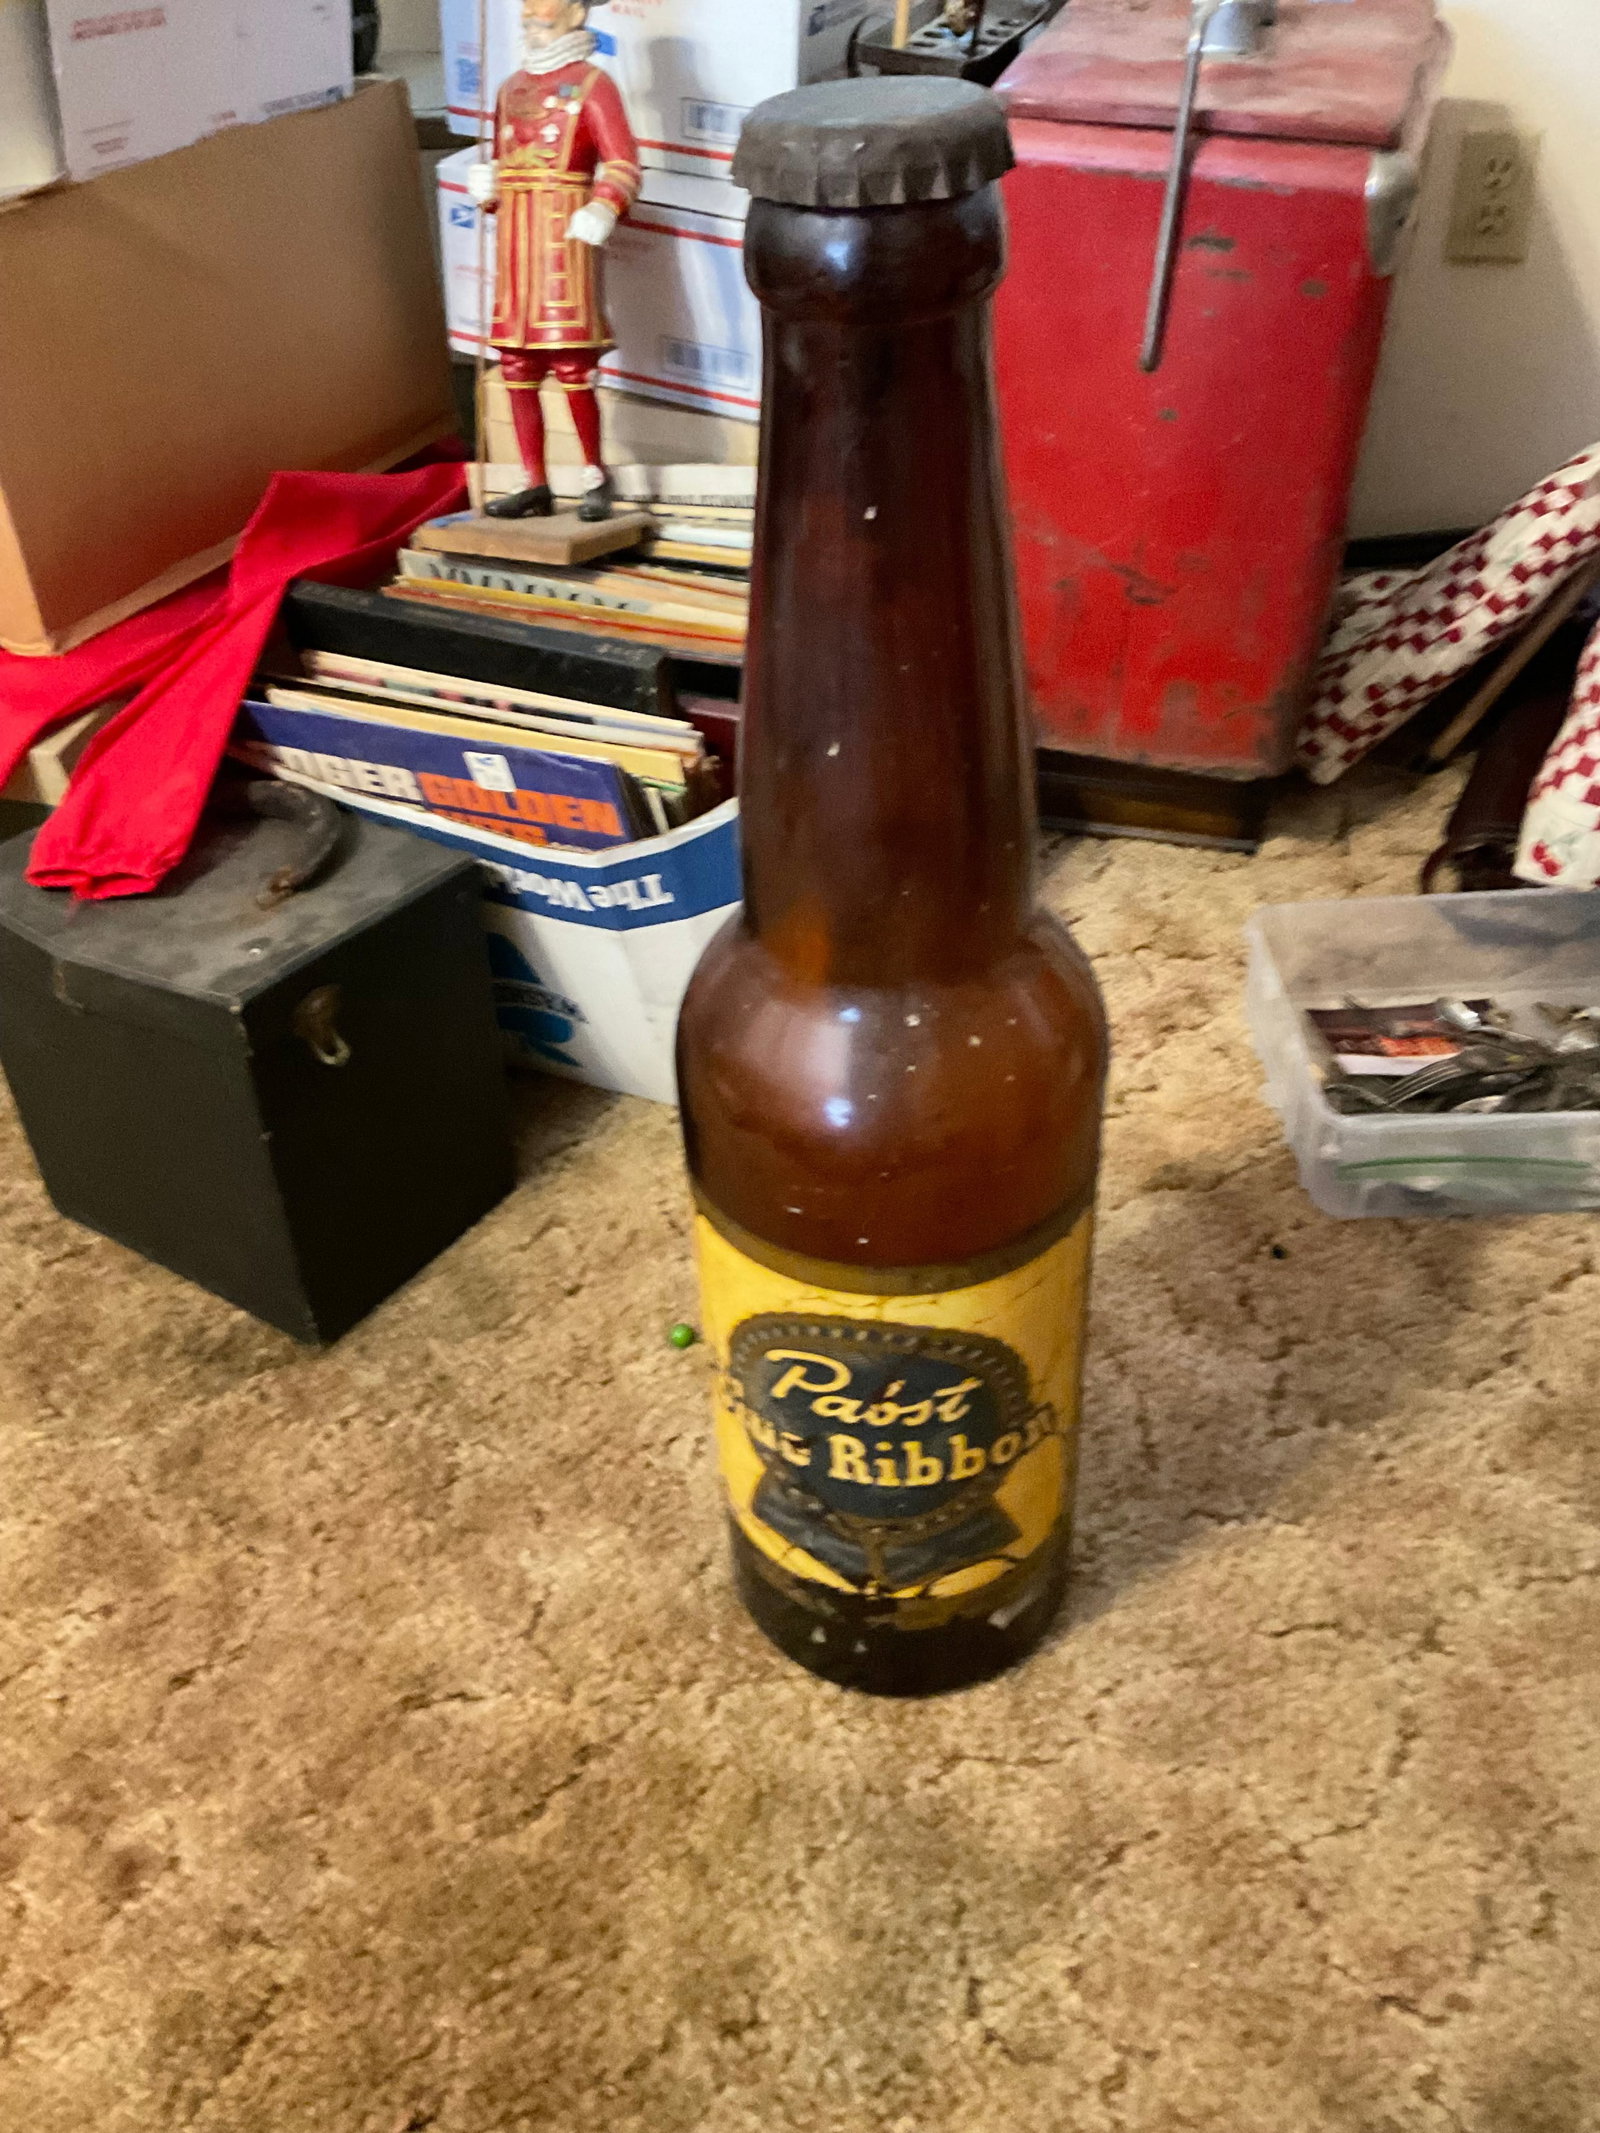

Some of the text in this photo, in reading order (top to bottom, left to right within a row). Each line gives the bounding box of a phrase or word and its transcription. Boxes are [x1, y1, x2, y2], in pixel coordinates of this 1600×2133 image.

[417, 772, 624, 836] GOLDEN
[586, 873, 675, 911] The
[827, 1405, 1055, 1487] Ribbon
